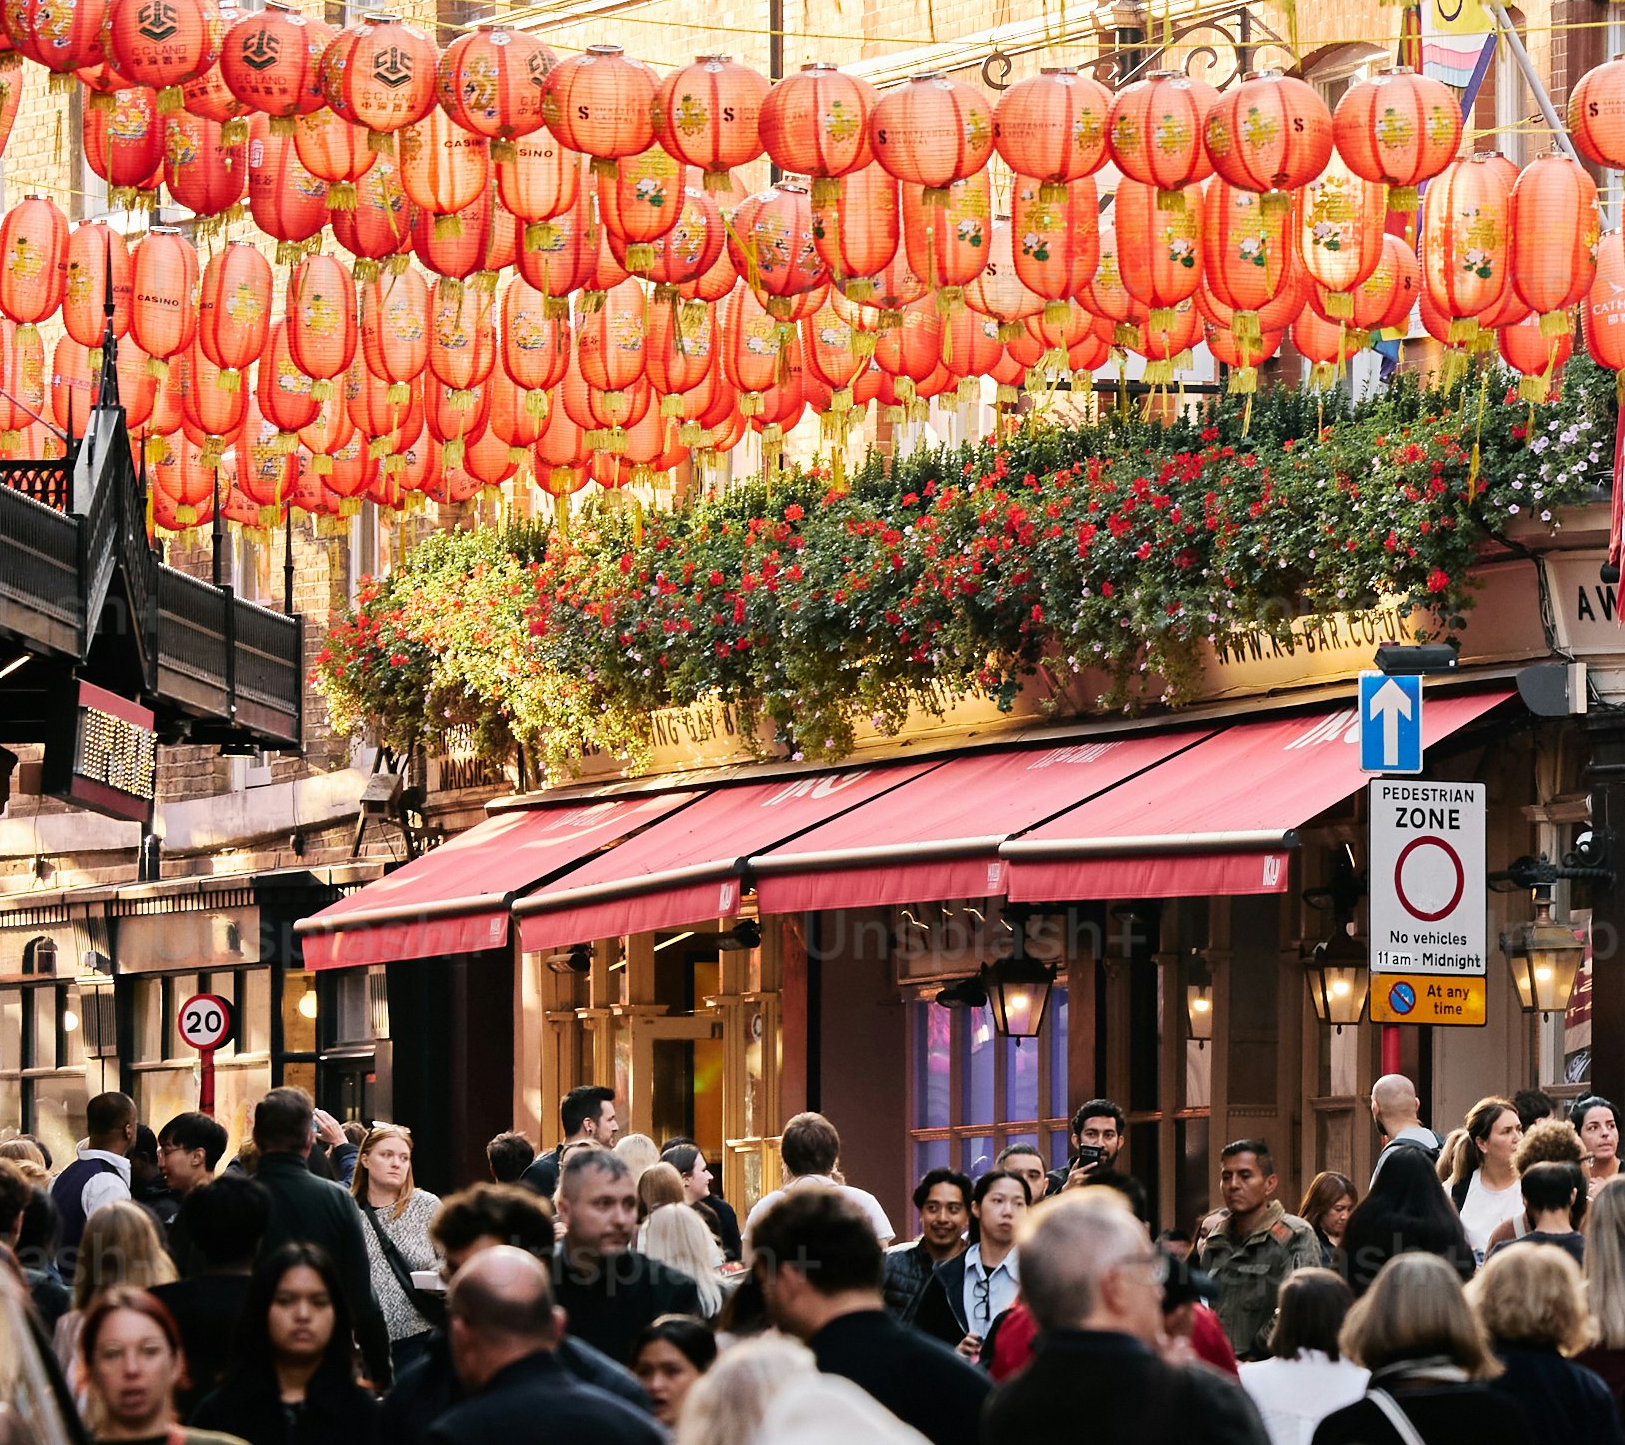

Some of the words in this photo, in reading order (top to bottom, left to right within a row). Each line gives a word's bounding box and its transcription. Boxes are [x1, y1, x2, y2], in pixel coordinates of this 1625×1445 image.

[154, 44, 187, 56] LAND
[386, 92, 418, 104] LAND
[138, 294, 179, 308] CASINO
[1383, 787, 1474, 803] PEDESTRIAN
[1395, 807, 1461, 830] ZONE
[1263, 855, 1280, 886] KU
[1390, 931, 1408, 945] No
[1414, 930, 1467, 945] vehicles
[1422, 951, 1481, 970] Midnight
[1427, 985, 1443, 998] At
[1448, 988, 1470, 1002] any
[1434, 1002, 1463, 1017] time
[186, 1011, 222, 1037] 20
